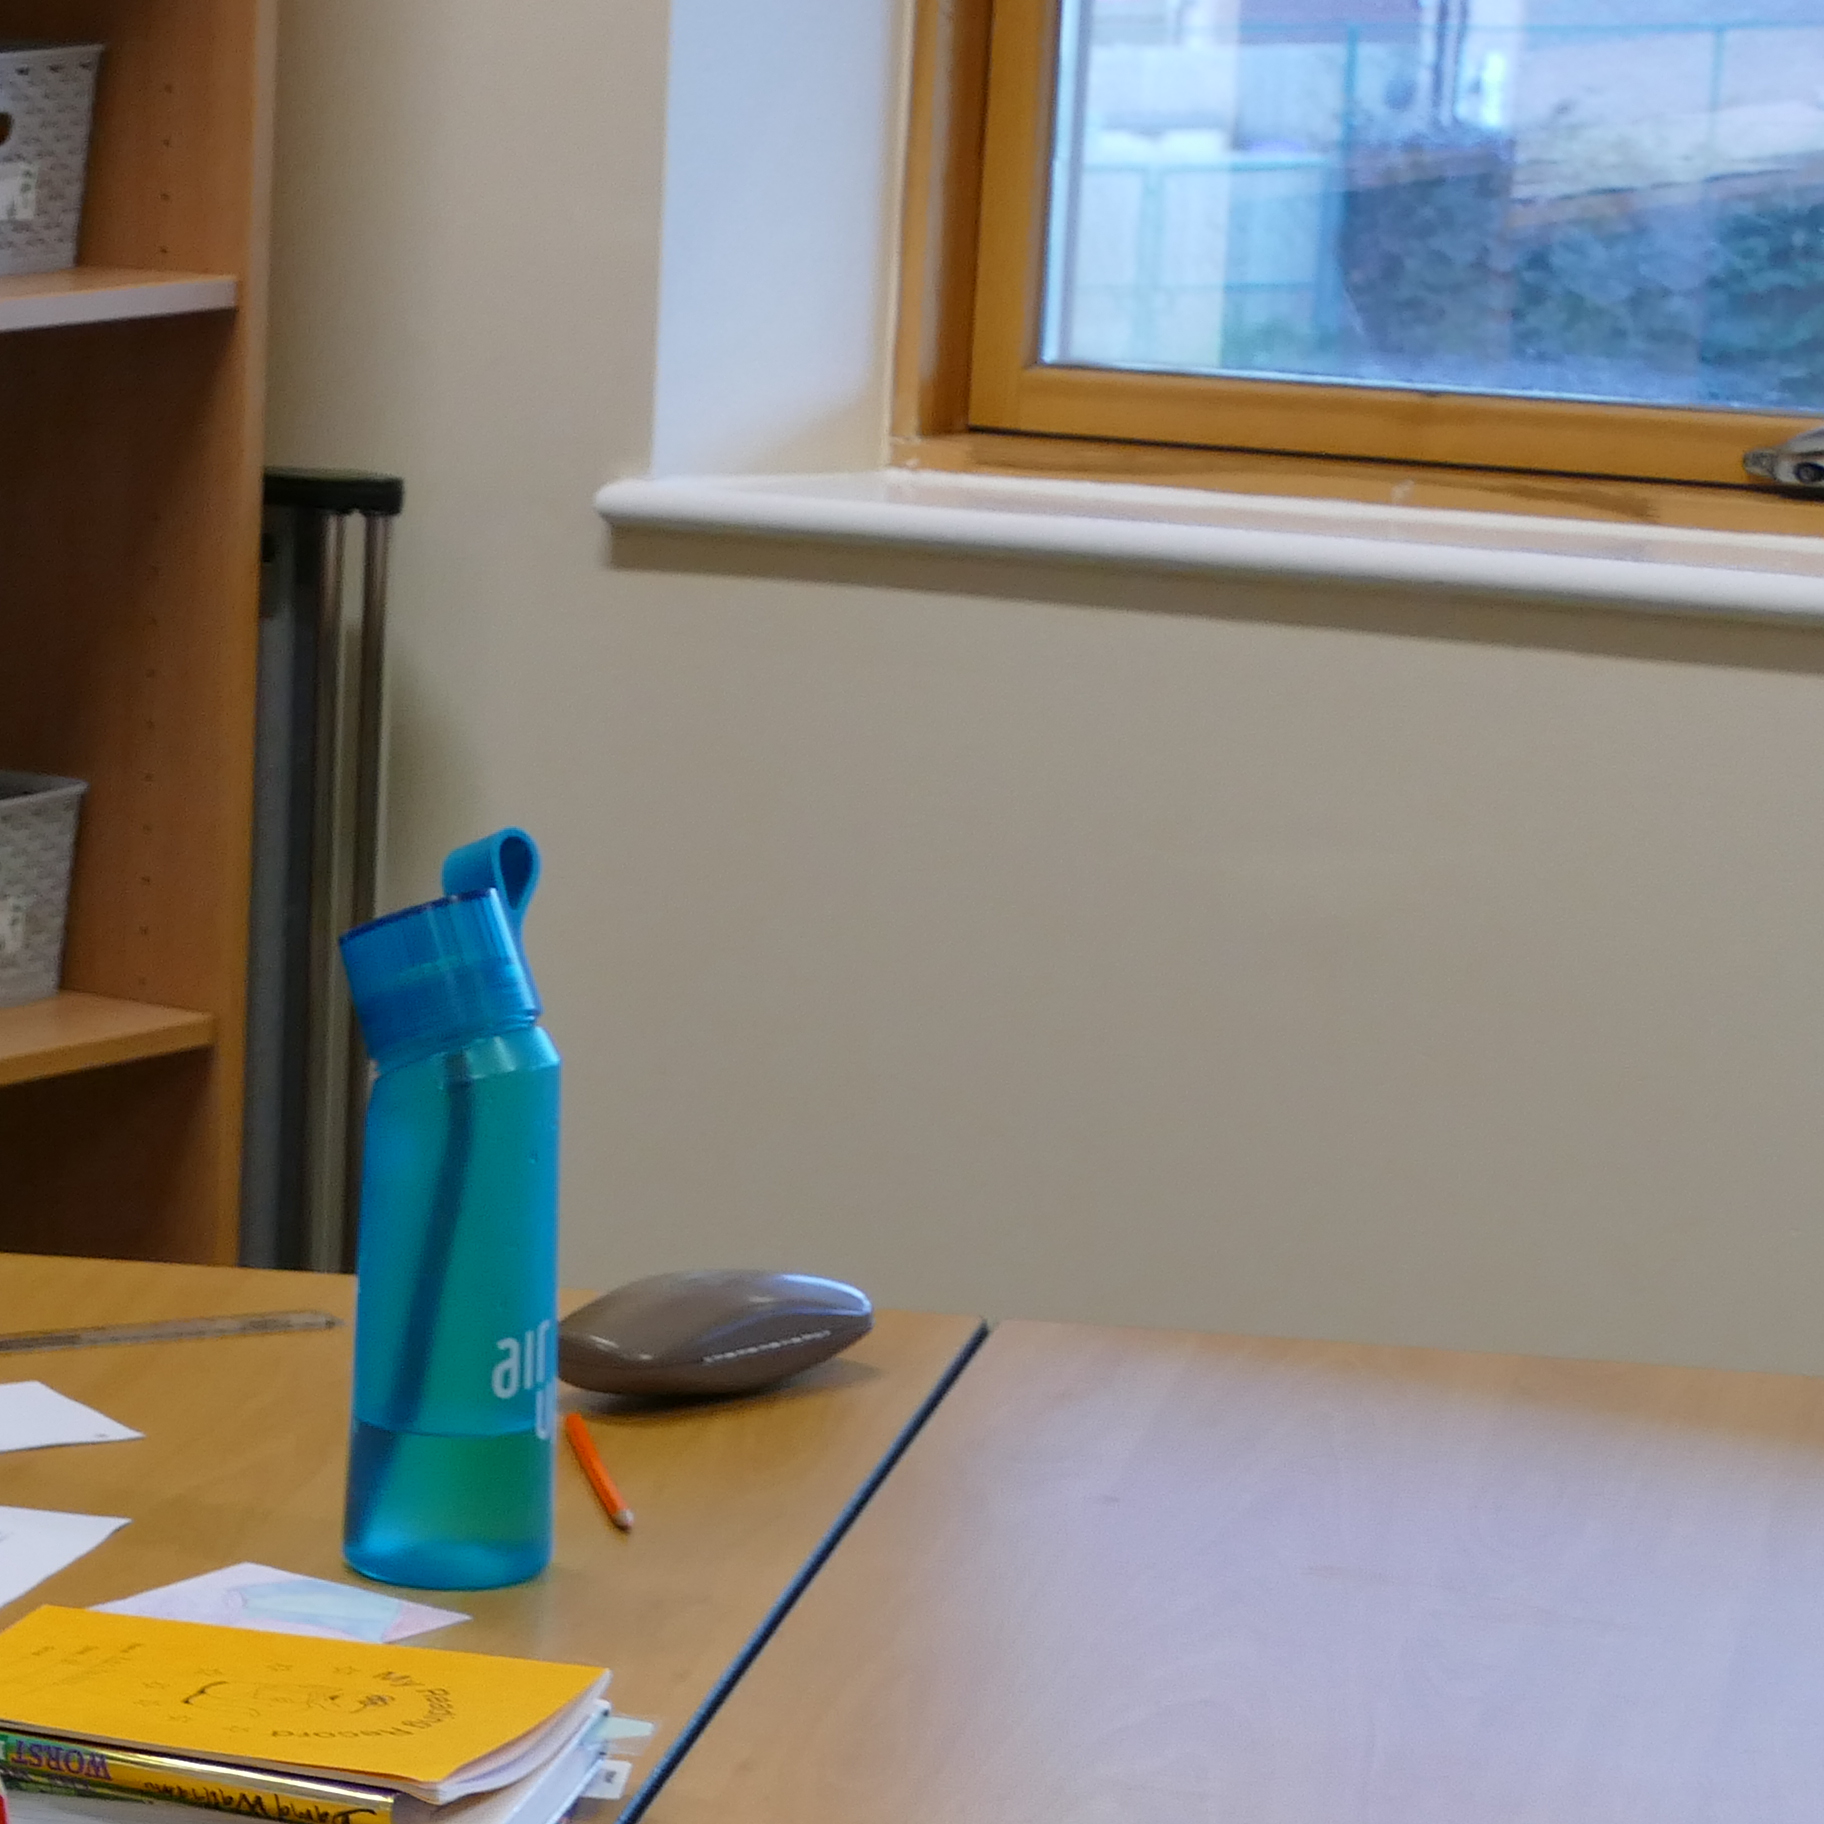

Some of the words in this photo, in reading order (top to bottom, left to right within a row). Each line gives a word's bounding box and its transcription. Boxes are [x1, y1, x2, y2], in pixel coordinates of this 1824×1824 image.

[491, 1319, 552, 1400] air
[271, 1725, 416, 1741] Record
[11, 1739, 113, 1781] WORST
